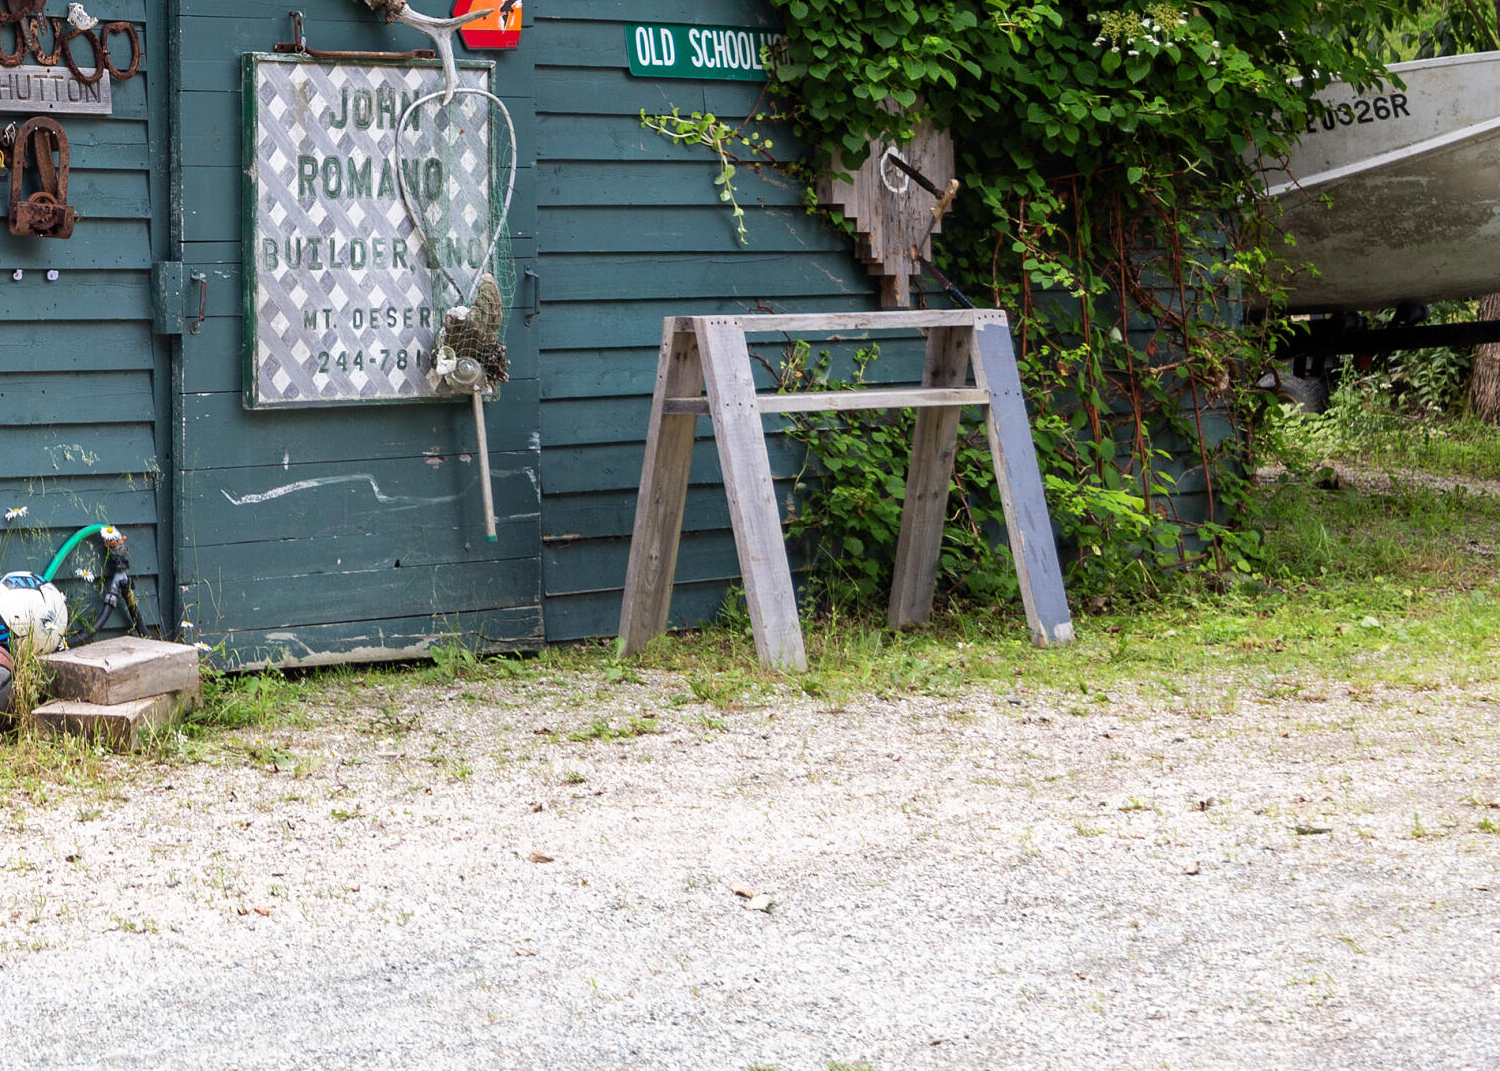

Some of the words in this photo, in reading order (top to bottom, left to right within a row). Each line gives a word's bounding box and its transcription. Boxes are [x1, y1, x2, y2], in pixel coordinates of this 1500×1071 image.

[635, 26, 676, 67] OLD
[328, 86, 421, 132] JOHN
[297, 156, 444, 201] ROMANO
[262, 236, 416, 274] BUILDER,
[303, 309, 337, 331] MT.
[317, 349, 438, 374] 244-781
